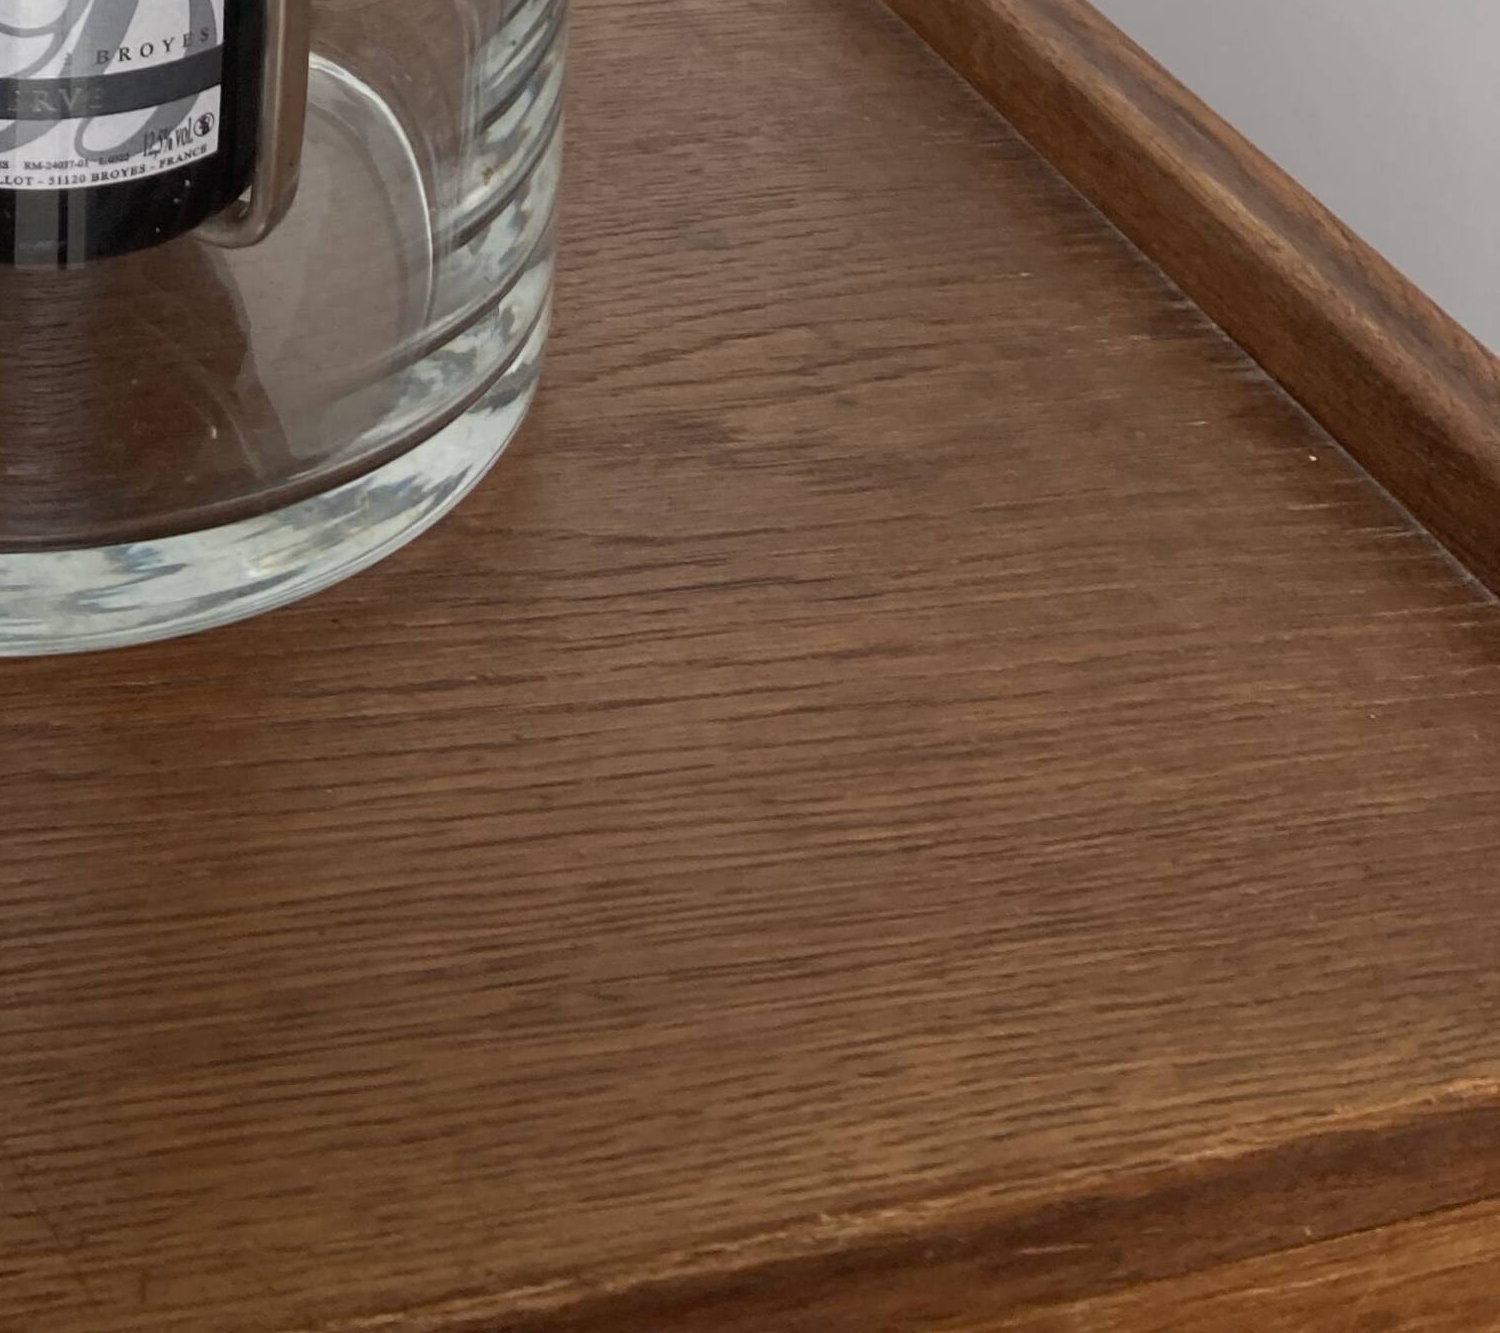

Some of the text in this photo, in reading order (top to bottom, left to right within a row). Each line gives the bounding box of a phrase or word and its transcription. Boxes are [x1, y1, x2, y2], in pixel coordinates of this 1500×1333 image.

[96, 26, 211, 65] BROYES
[49, 174, 87, 185] 51120
[91, 163, 147, 182] BROYES
[159, 144, 208, 169] FRANCE
